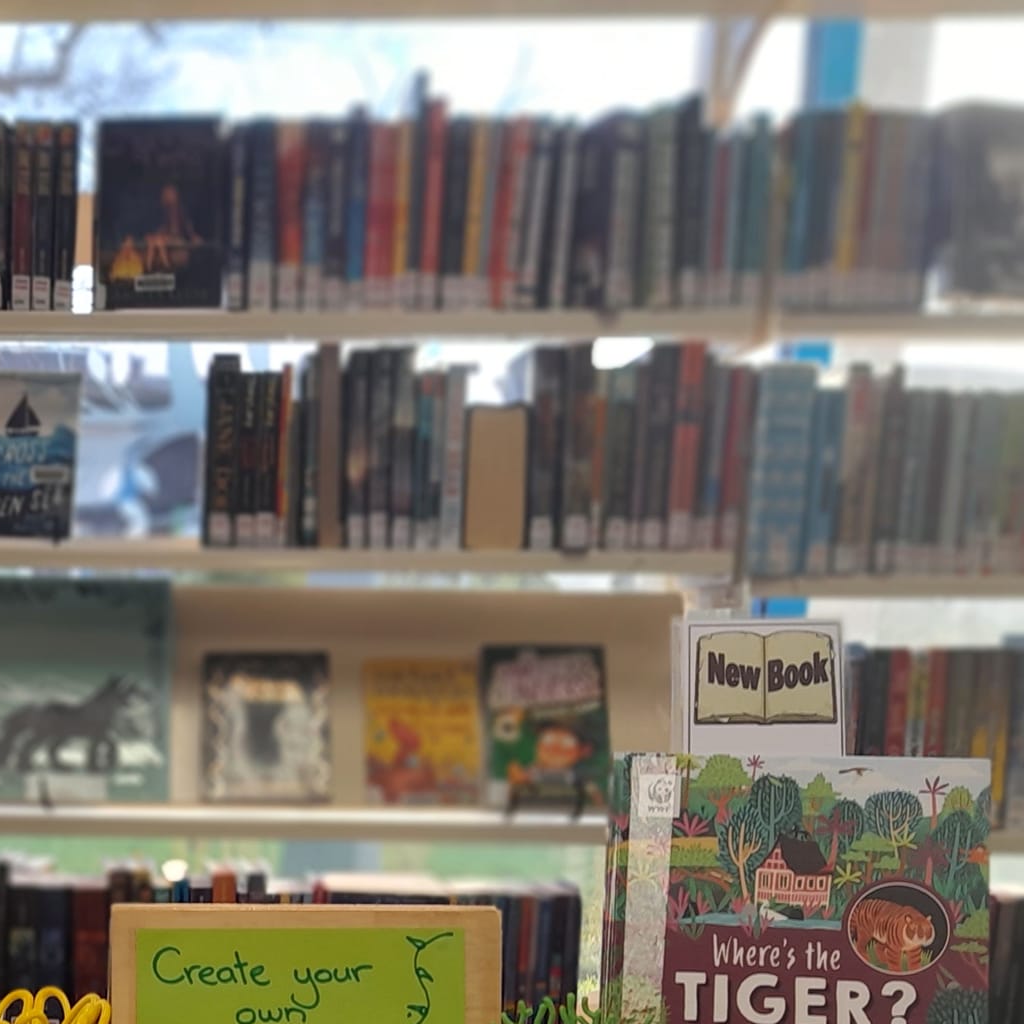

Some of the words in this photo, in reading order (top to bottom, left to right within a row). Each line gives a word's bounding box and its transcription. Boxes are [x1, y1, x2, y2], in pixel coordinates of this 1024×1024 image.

[707, 652, 760, 691] New
[767, 652, 828, 692] Book
[713, 934, 796, 971] Where's
[805, 939, 841, 971] the
[152, 946, 270, 986] Create
[291, 963, 373, 1010] your
